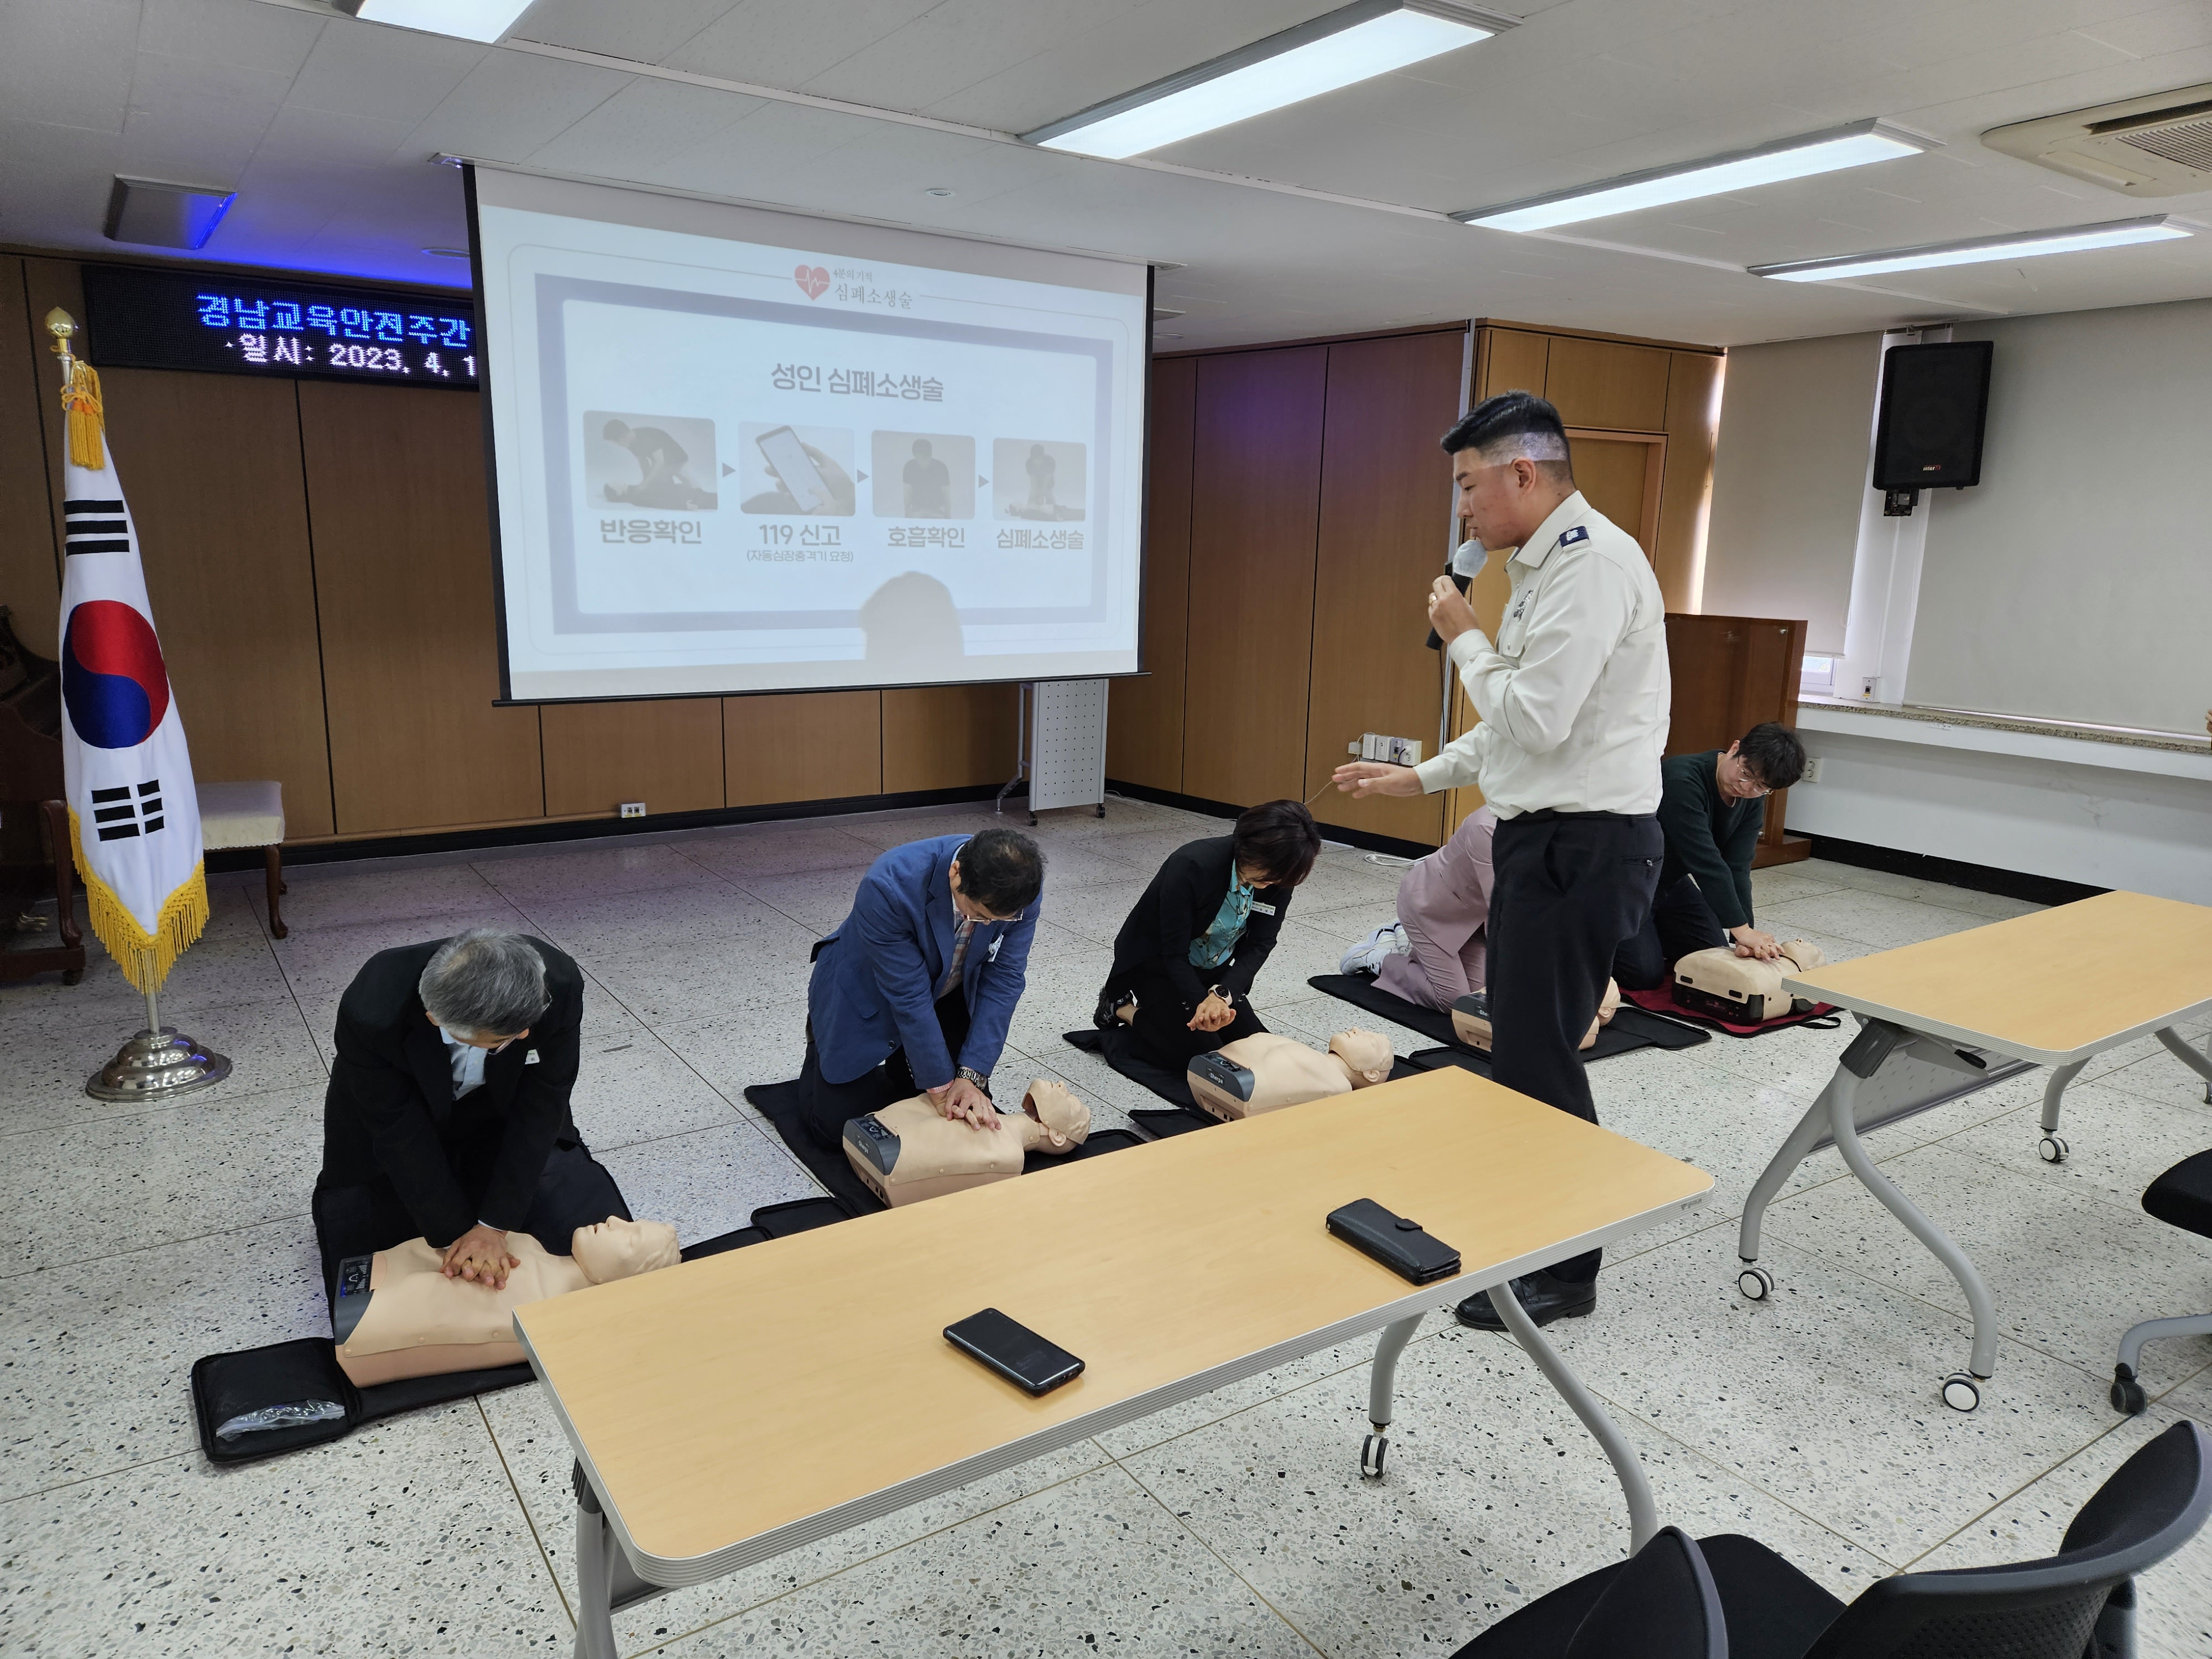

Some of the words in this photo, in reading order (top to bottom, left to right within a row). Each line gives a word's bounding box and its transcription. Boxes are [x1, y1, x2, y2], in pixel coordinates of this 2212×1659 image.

[833, 268, 854, 280] 4분의
[856, 271, 872, 283] 기적
[835, 283, 912, 309] 심폐소생술
[196, 294, 471, 348] 경남교육안전주간
[328, 343, 410, 374] 2023.
[424, 352, 450, 378] 4.
[771, 363, 821, 392] 성인
[827, 368, 944, 402] 심폐소생술
[600, 519, 702, 544] 반응확인
[759, 524, 793, 545] 119
[799, 525, 841, 546] 신고
[888, 526, 965, 549] 호흡확인
[996, 528, 1084, 550] 심폐소생술
[747, 550, 827, 562] (자동심장충격기
[830, 551, 853, 562] 요청)
